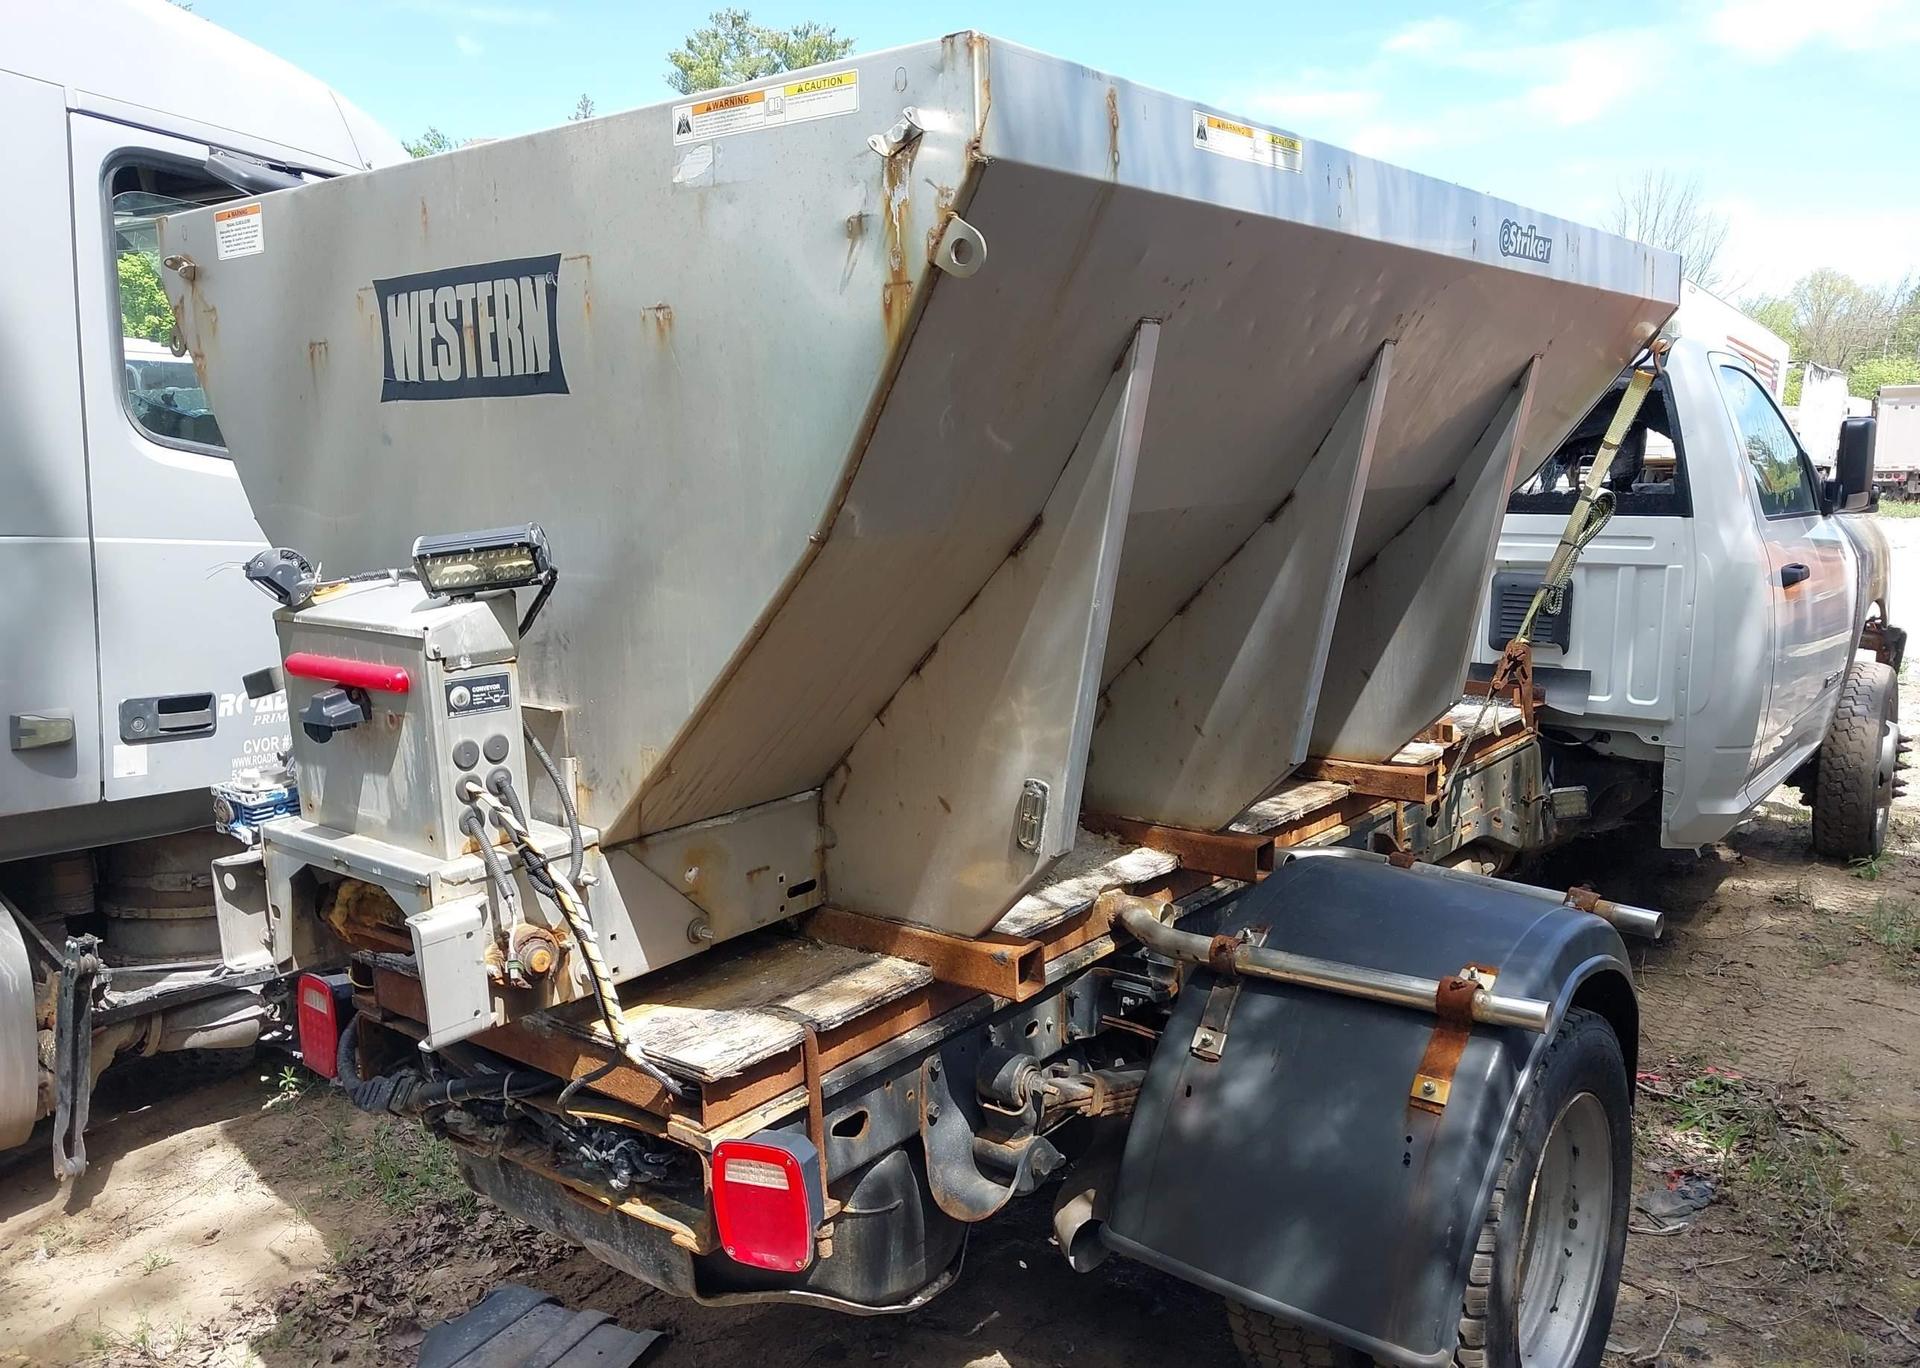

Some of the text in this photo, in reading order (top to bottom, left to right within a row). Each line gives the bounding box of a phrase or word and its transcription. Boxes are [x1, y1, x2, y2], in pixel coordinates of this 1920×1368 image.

[804, 76, 843, 91] CAUTION
[711, 95, 750, 111] WARNING
[472, 683, 501, 693] CONVEYOR
[243, 736, 280, 754] CVOR
